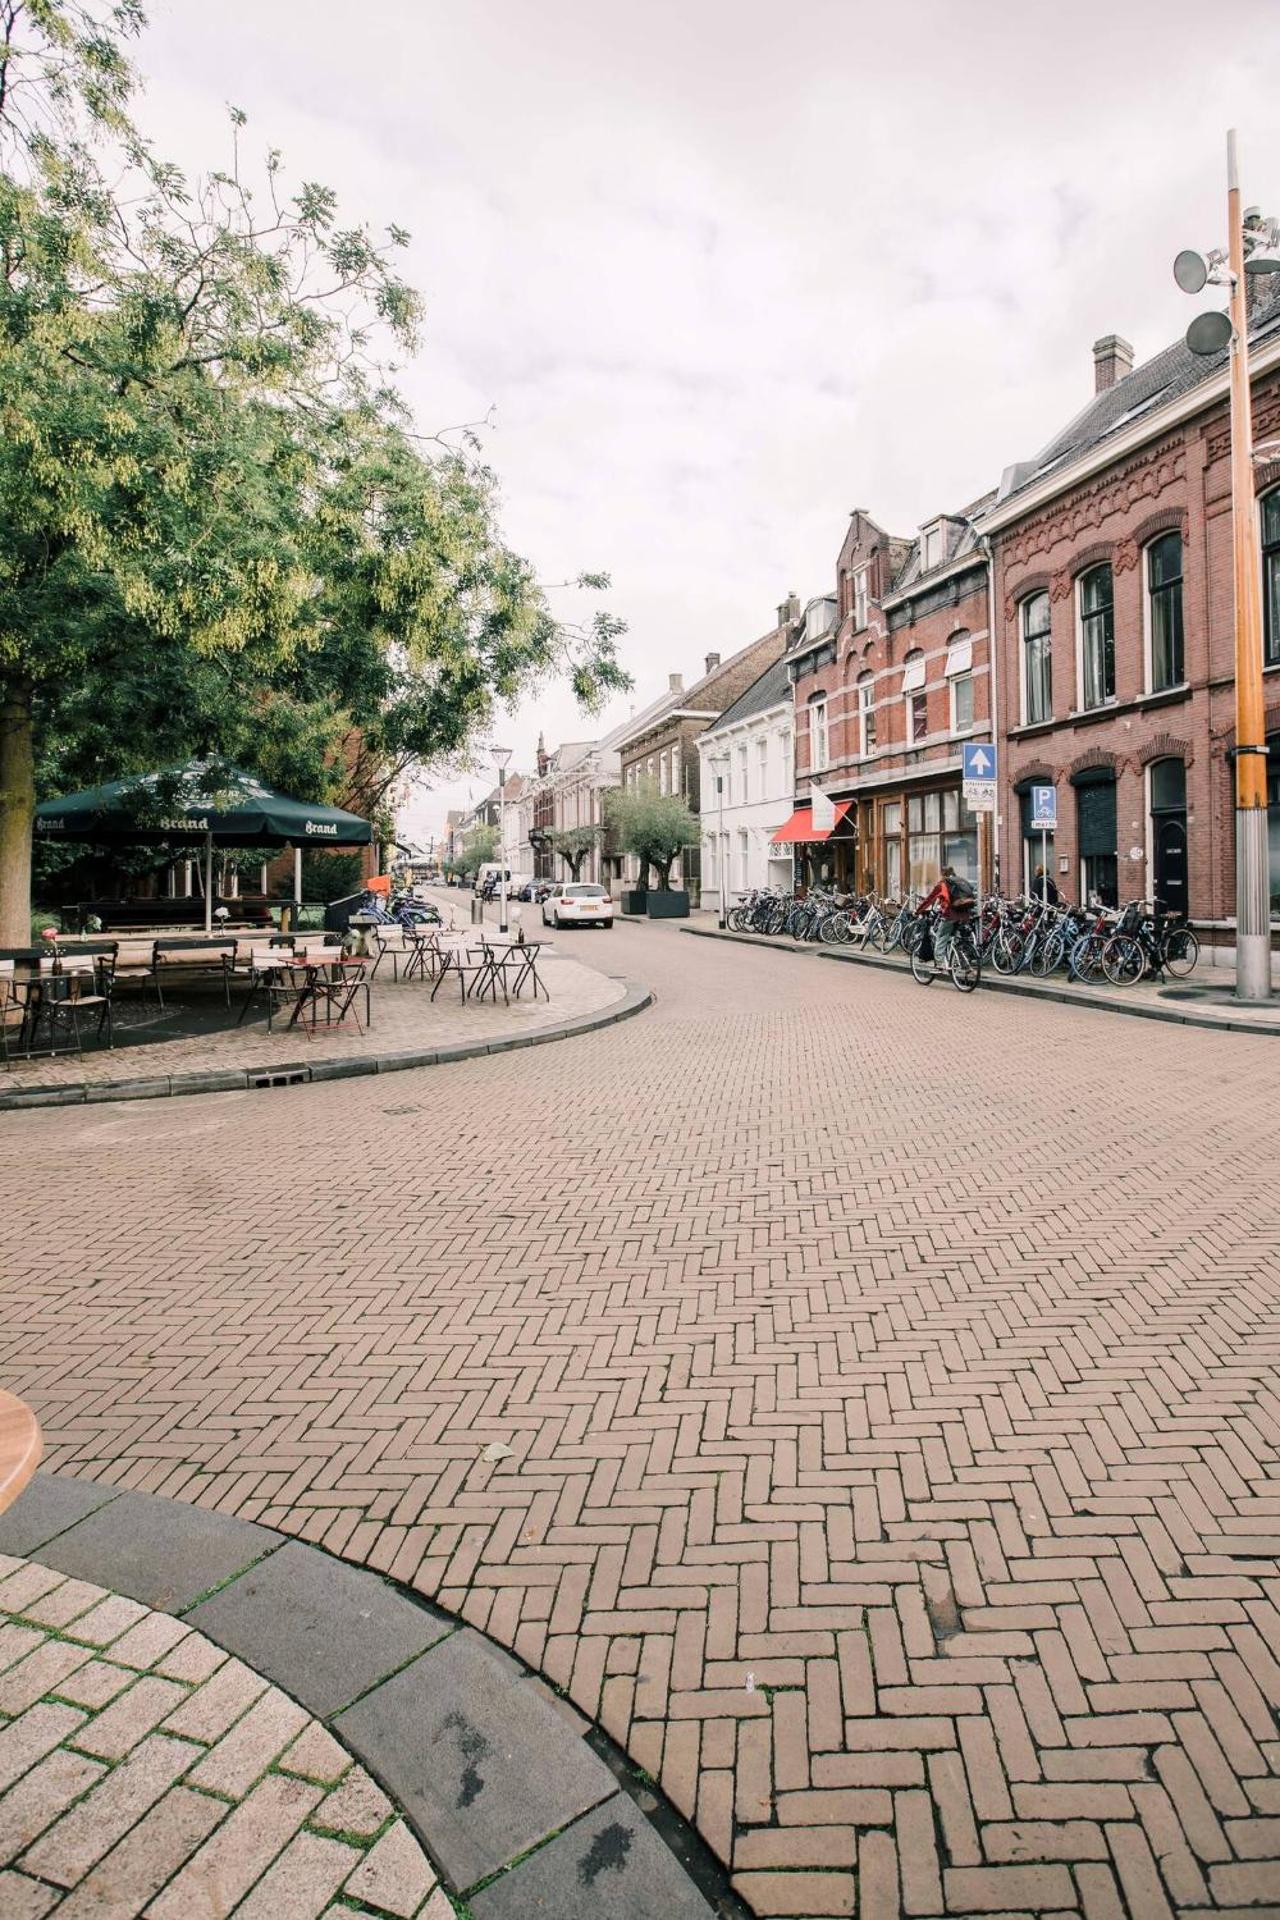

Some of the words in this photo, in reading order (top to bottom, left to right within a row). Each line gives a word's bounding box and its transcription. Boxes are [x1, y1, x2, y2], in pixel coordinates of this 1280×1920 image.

[1039, 789, 1051, 805] P
[160, 816, 209, 830] Brand
[305, 820, 338, 834] Brand
